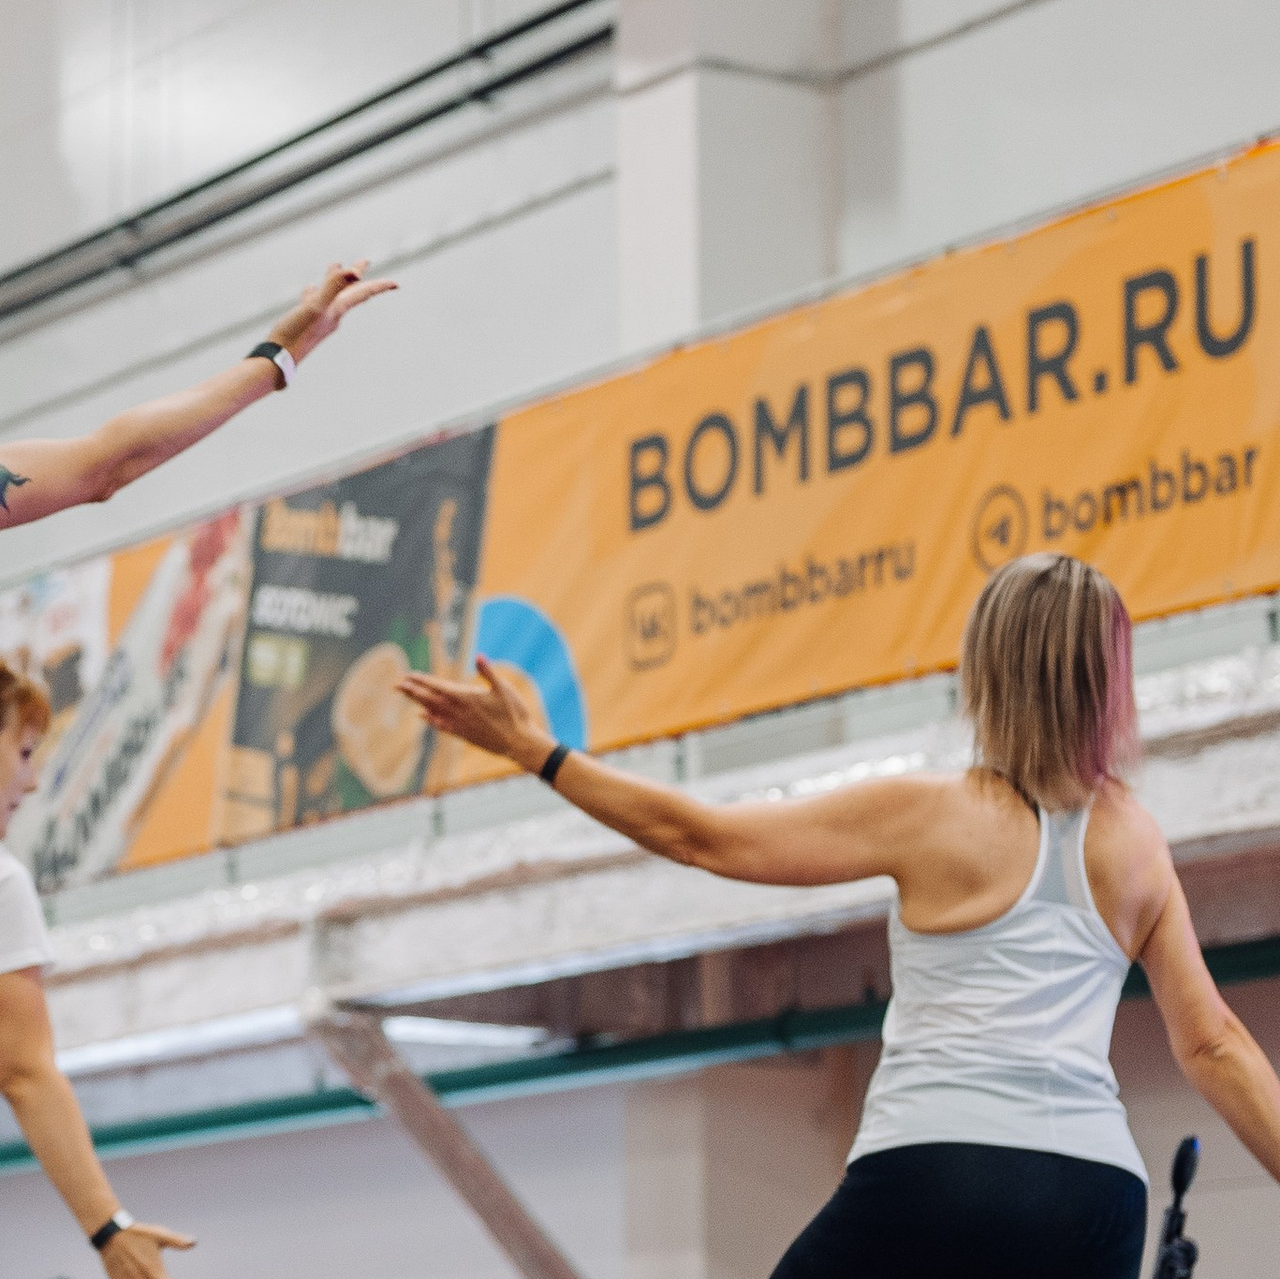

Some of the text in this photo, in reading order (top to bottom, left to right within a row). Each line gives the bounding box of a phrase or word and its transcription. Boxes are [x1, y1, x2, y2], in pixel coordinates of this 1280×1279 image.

[629, 238, 1258, 532] BOMBBAR.RU
[1041, 446, 1260, 541] bombbar
[689, 541, 916, 635] bombbarru
